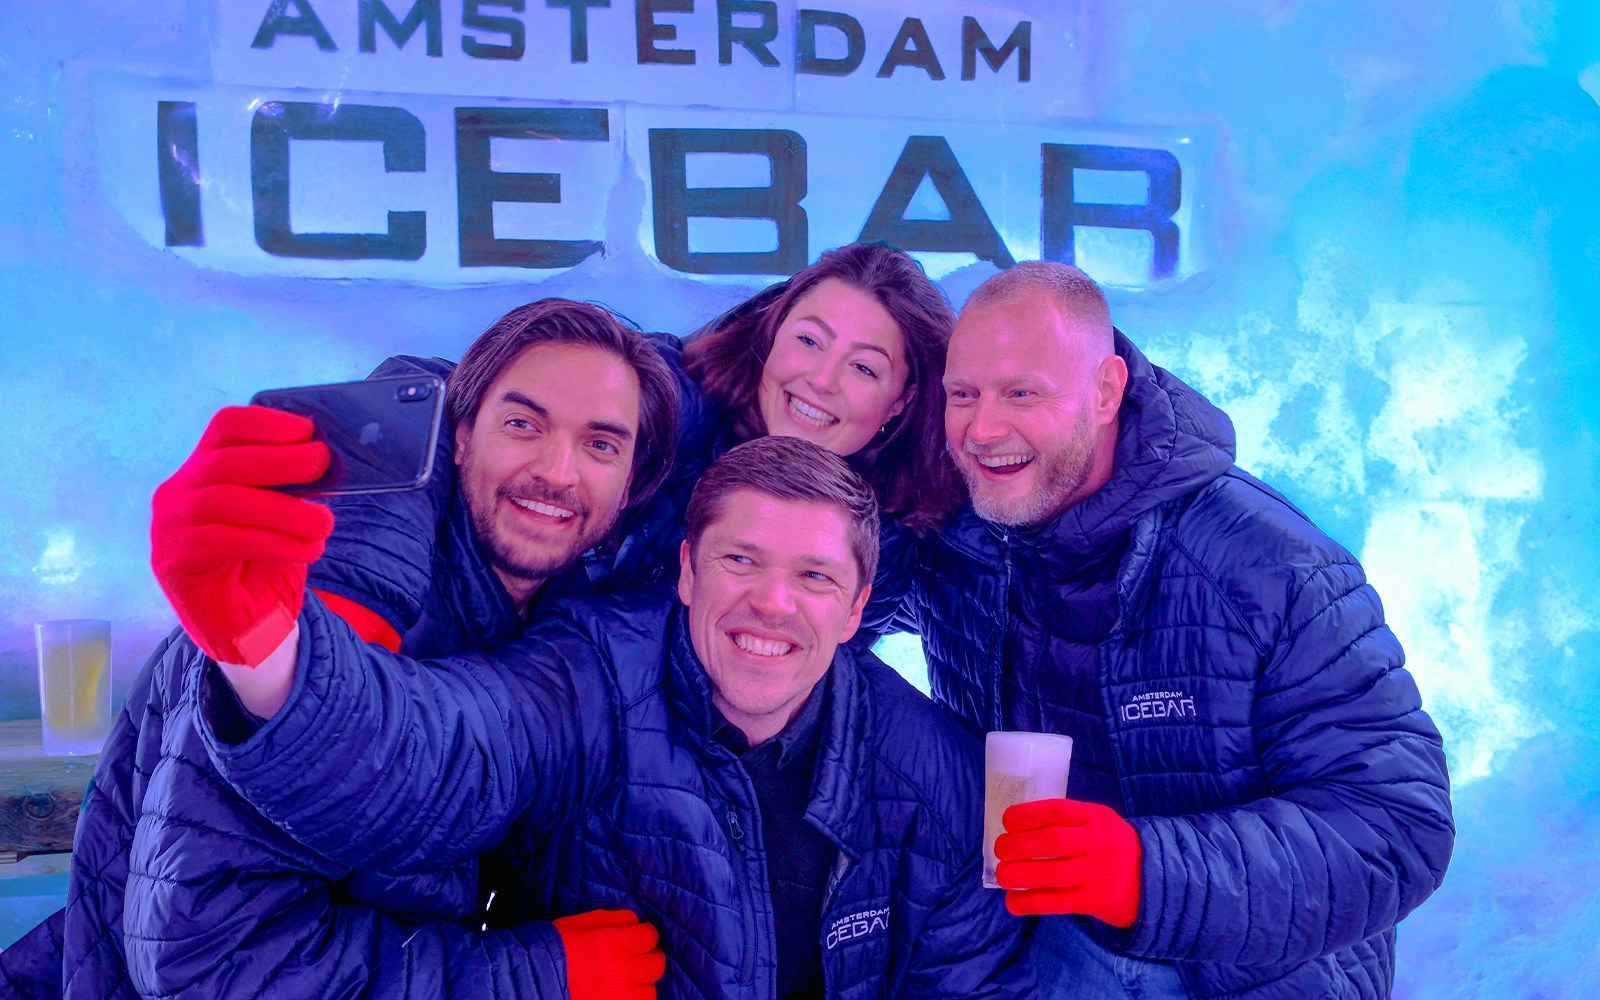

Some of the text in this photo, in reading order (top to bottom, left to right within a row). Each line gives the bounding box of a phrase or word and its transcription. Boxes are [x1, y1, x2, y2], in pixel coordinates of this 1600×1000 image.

[251, 0, 1031, 82] AMSTERDAM
[157, 100, 1182, 281] ICEBAR
[1121, 698, 1196, 721] ICEBAR
[1132, 691, 1183, 702] AMSTERDAM
[826, 912, 890, 950] CEBA
